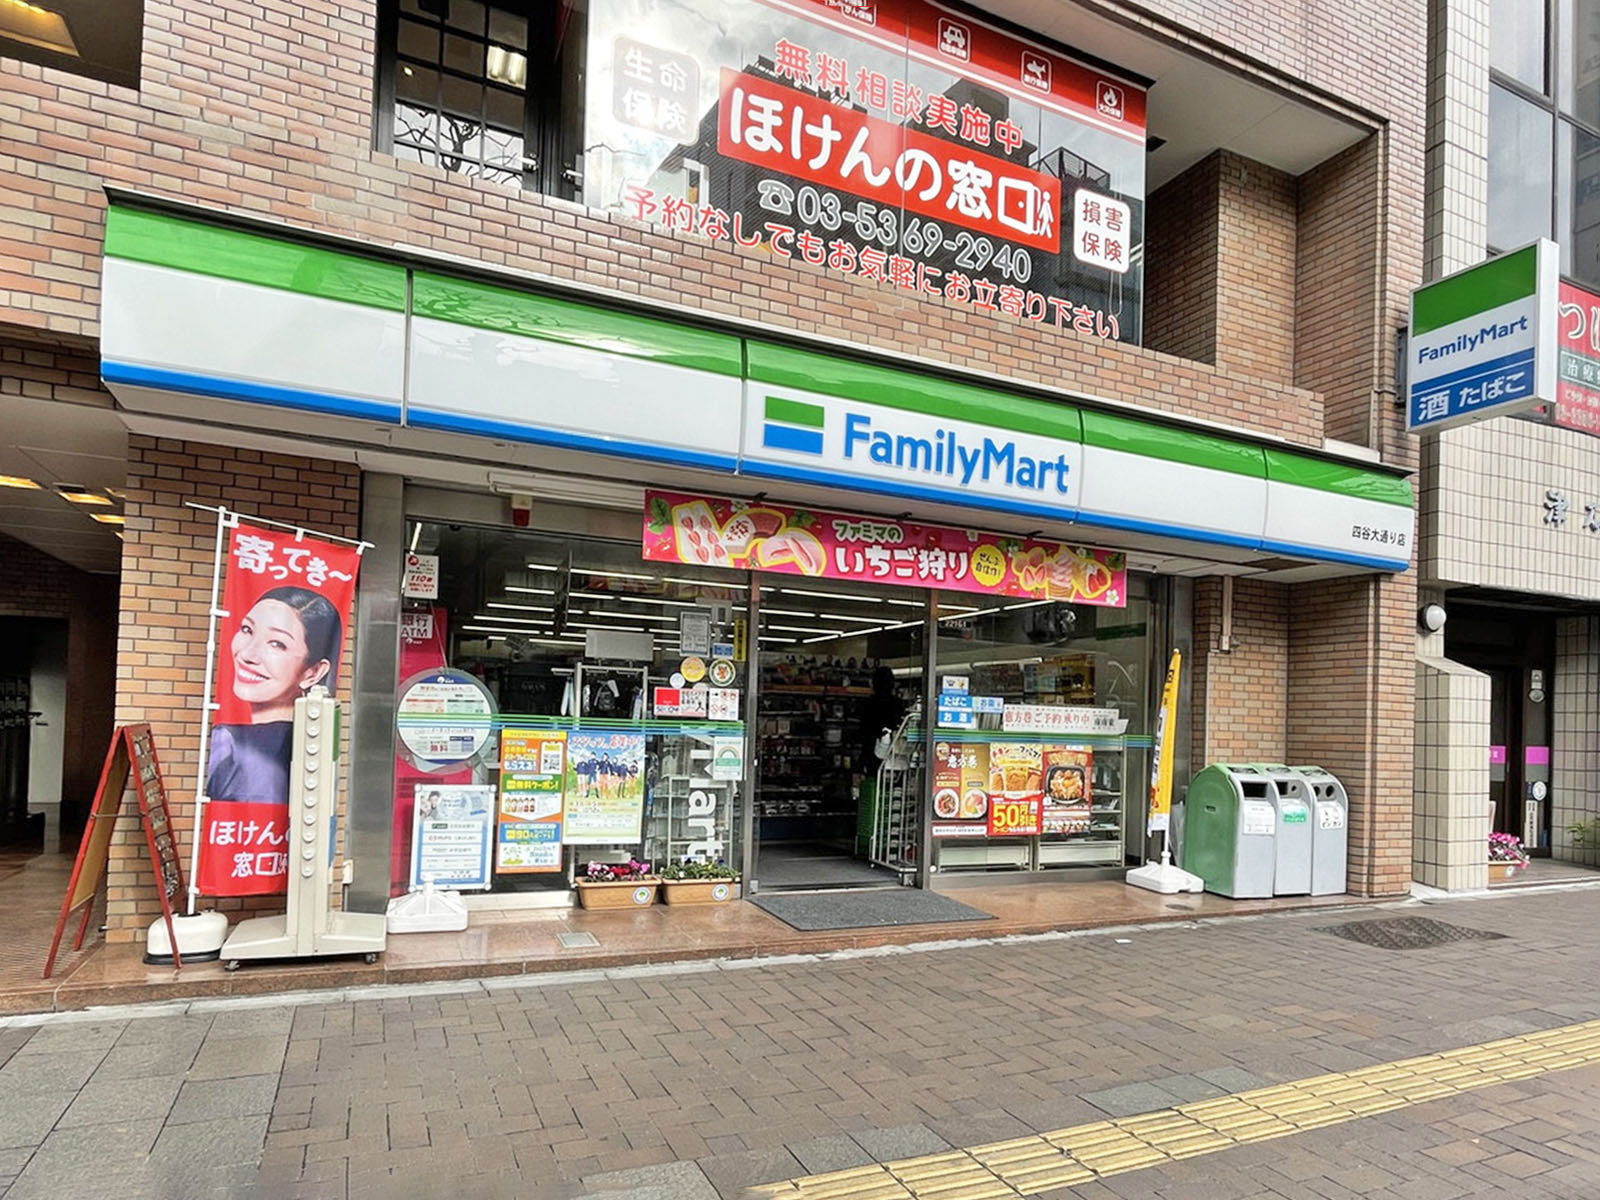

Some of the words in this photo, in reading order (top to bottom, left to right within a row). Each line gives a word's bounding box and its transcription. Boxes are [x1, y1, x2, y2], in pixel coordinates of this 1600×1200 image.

[623, 46, 690, 92] 生命
[775, 40, 1023, 155] 無料相談実施中
[730, 86, 1036, 237] ほけんの窓口
[797, 188, 1031, 283] 03-5369-2940
[1082, 198, 1124, 232] 損害
[625, 185, 1120, 341] 予約なしでもお気軽にお立寄り下さい
[1081, 230, 1122, 264] 保険
[1418, 315, 1528, 364] FamilyMart
[1418, 391, 1449, 421] 酒
[1459, 371, 1526, 408] たばこ
[843, 413, 1069, 493] FamilyMart
[833, 520, 902, 543] ファミマの
[1352, 525, 1405, 546] 四谷大通り店
[835, 544, 968, 580] いちご狩り
[401, 627, 428, 637] ATM
[209, 820, 291, 845] ほけん
